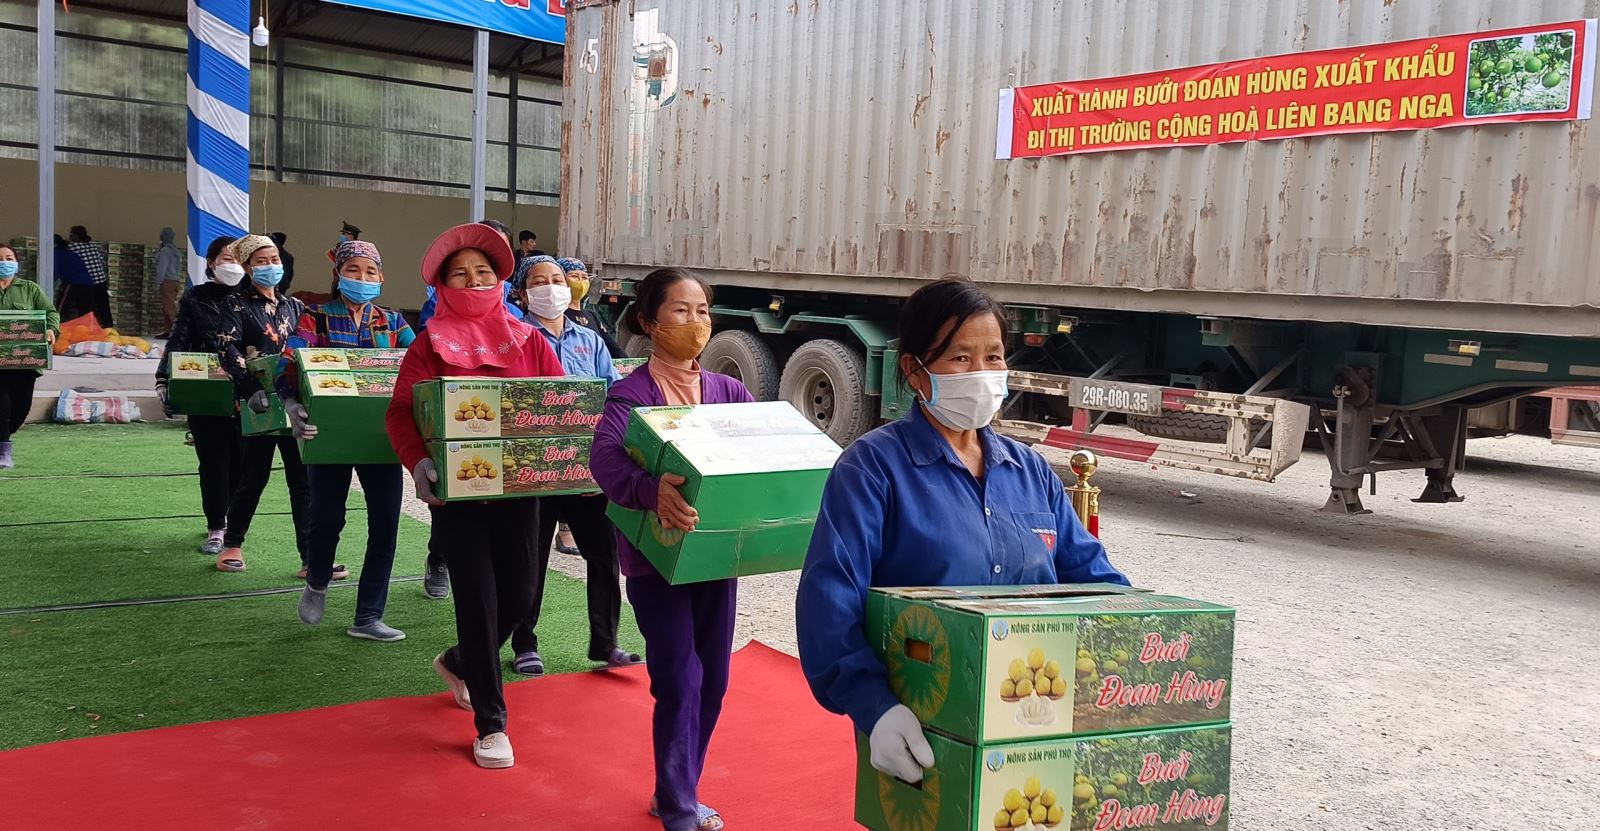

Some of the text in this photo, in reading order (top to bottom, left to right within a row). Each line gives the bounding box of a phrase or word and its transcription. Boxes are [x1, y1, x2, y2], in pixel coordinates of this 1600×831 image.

[1030, 43, 1456, 117] XUẤT HÀNH BƯỞI ĐOAN HÙNG XUẤT KHẨU
[1027, 93, 1455, 150] ĐI THỊ TRƯỜNG CỘNG HOÀ LIÊN BANG NGA
[1082, 386, 1148, 412] 29R-080.35
[515, 409, 558, 426] Đoan
[517, 466, 560, 483] Đoan
[1010, 620, 1030, 634] NÔNG
[1031, 619, 1045, 633] SẢN
[1061, 622, 1074, 634] THỌ
[1096, 670, 1227, 710] Đoan Hùng
[1093, 788, 1226, 831] Đoan Hùng
